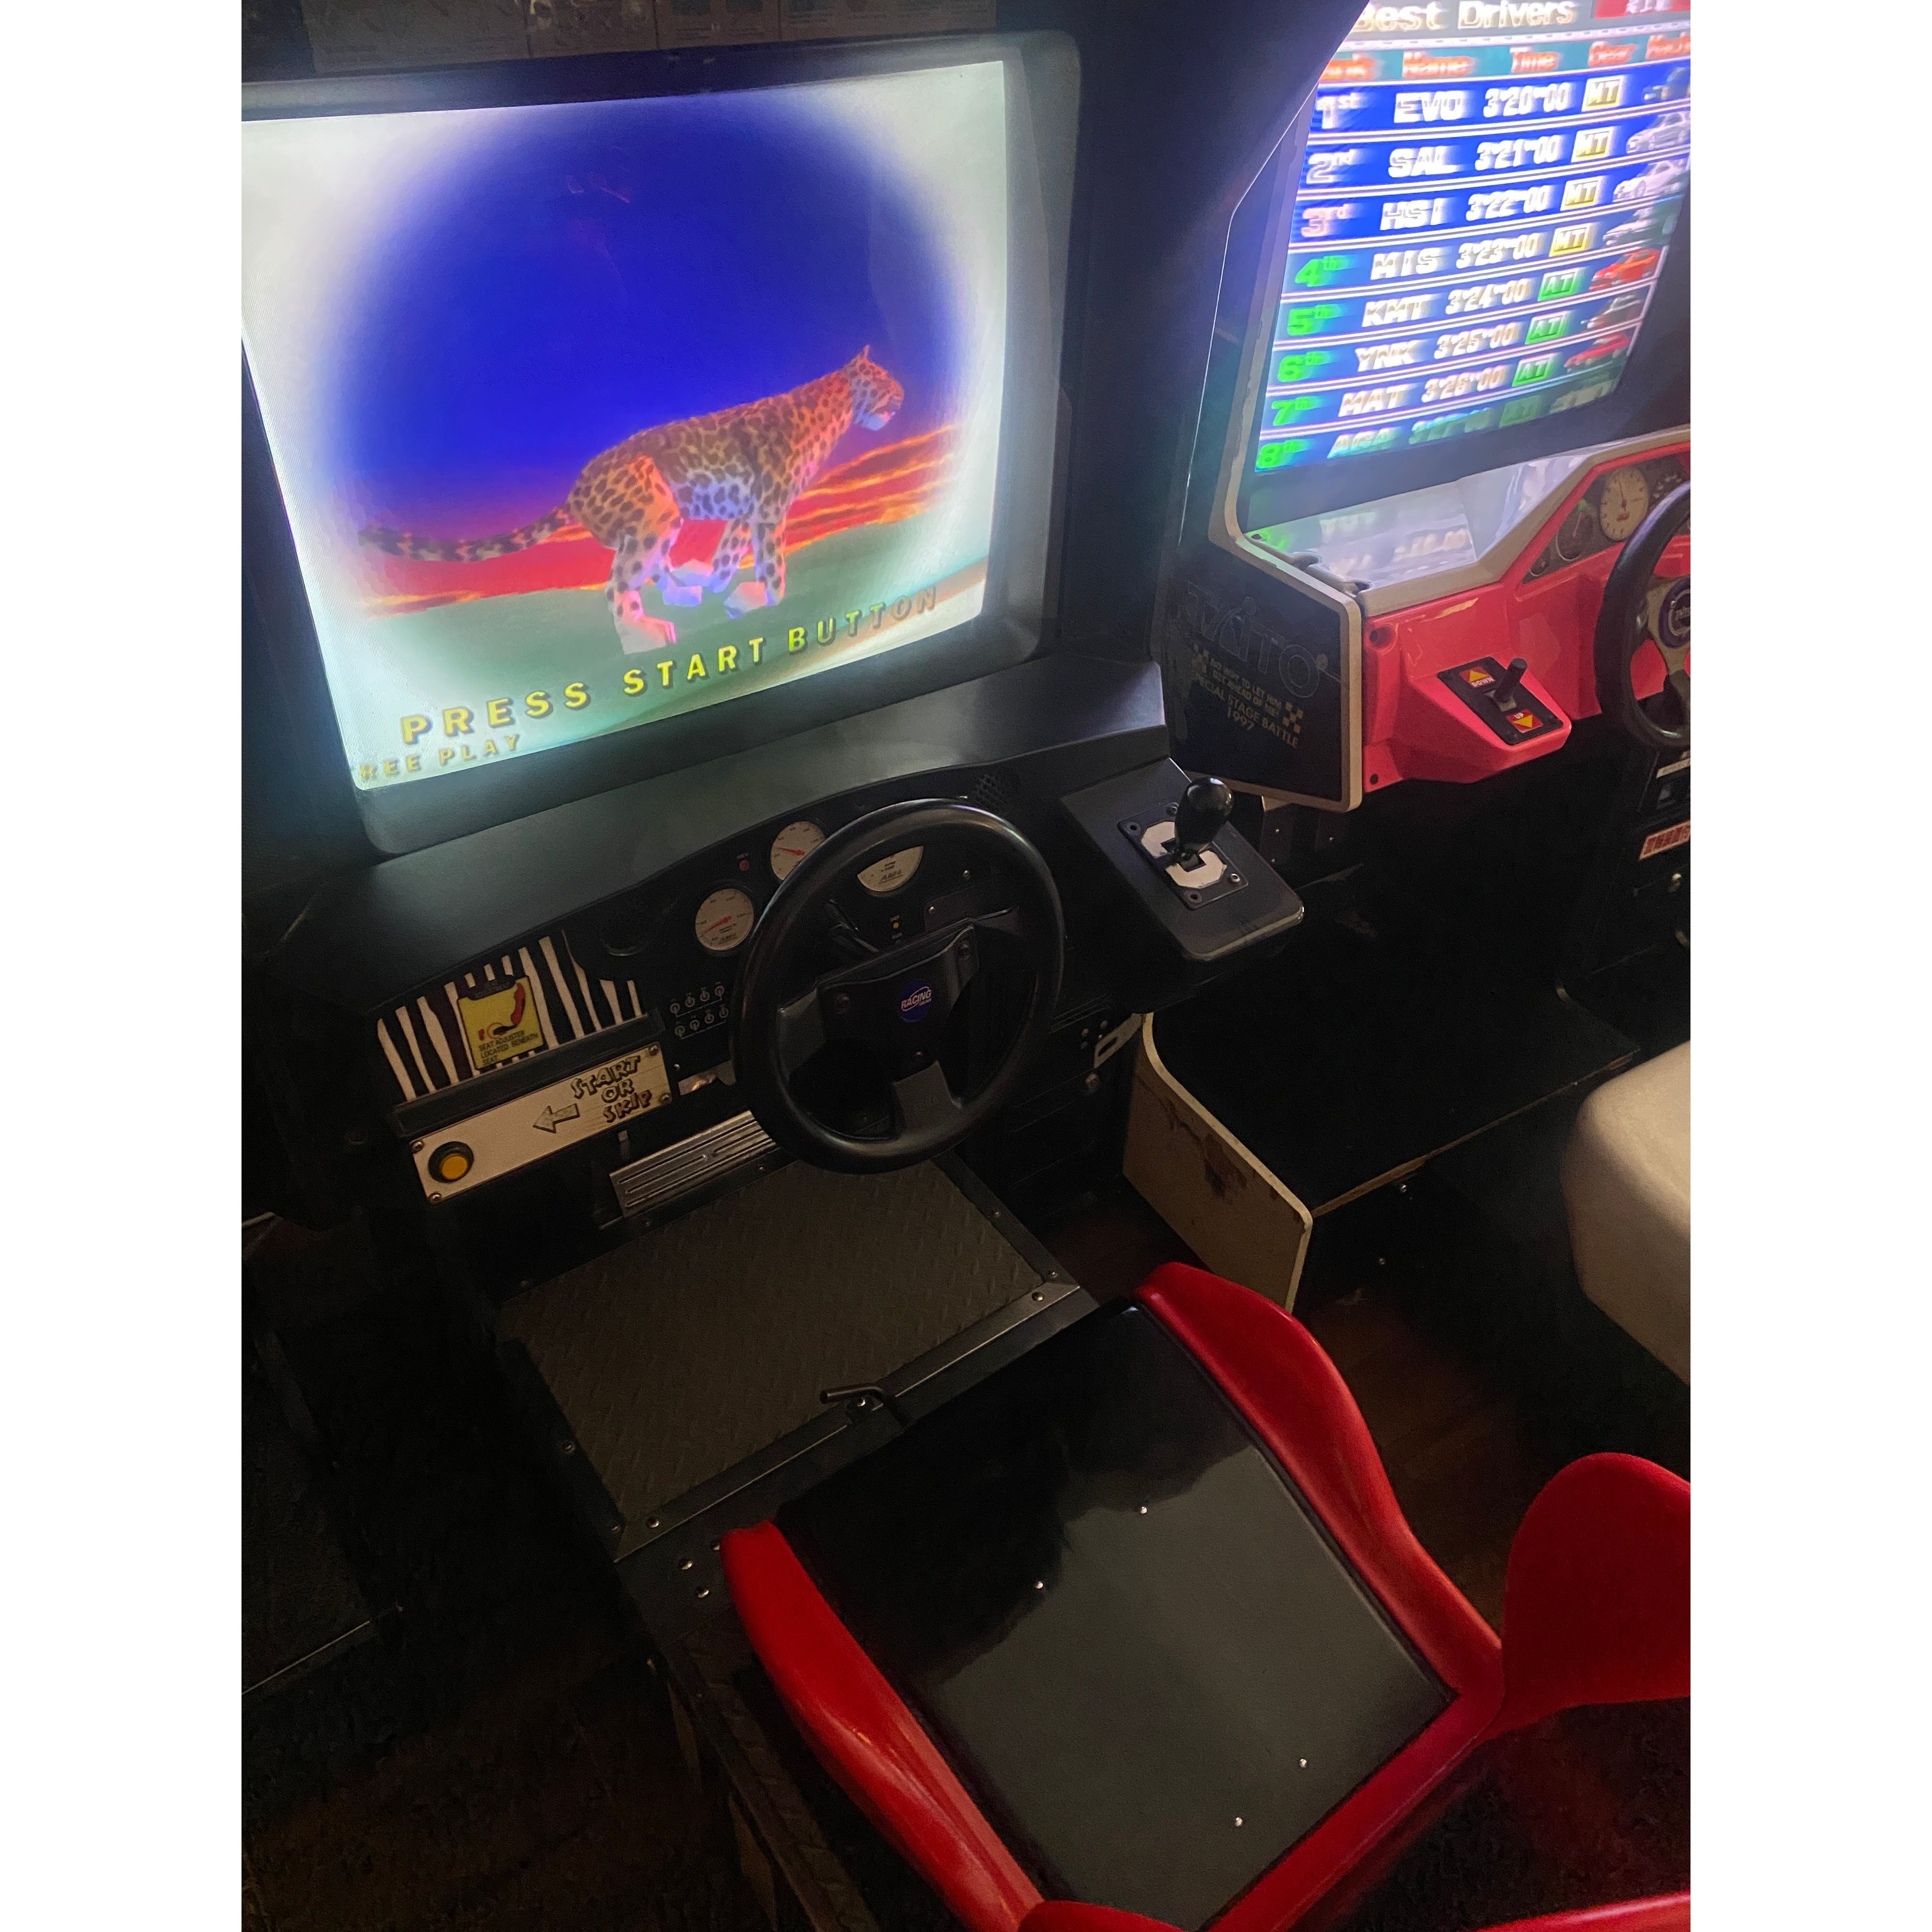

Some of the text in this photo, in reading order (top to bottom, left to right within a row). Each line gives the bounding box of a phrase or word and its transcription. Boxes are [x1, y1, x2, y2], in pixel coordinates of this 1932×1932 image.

[1458, 0, 1576, 30] Drivers
[1402, 50, 1473, 78] Name
[1509, 47, 1561, 73] Time
[1394, 90, 1467, 123] EVO
[1388, 146, 1458, 177] SAL
[1361, 294, 1433, 327] KMT
[1355, 340, 1419, 372] YNK
[1338, 384, 1411, 417] MAT
[401, 586, 937, 746] PRESS START BUTTON
[1242, 678, 1251, 688] TO
[1253, 684, 1265, 697] LET
[1472, 677, 1495, 688] DOWN
[1253, 696, 1262, 706] OF
[1227, 706, 1255, 732] 1997
[1228, 694, 1259, 722] STAGE
[1262, 716, 1299, 748] BATTLE
[438, 733, 520, 766] PLAY
[901, 989, 932, 1008] RACING
[479, 1030, 525, 1052] SEAT ADJUSTER
[481, 1033, 538, 1059] LOCATED BENEATH
[570, 1055, 641, 1100] START
[601, 1079, 635, 1104] OR
[603, 1089, 652, 1123] SKIP
